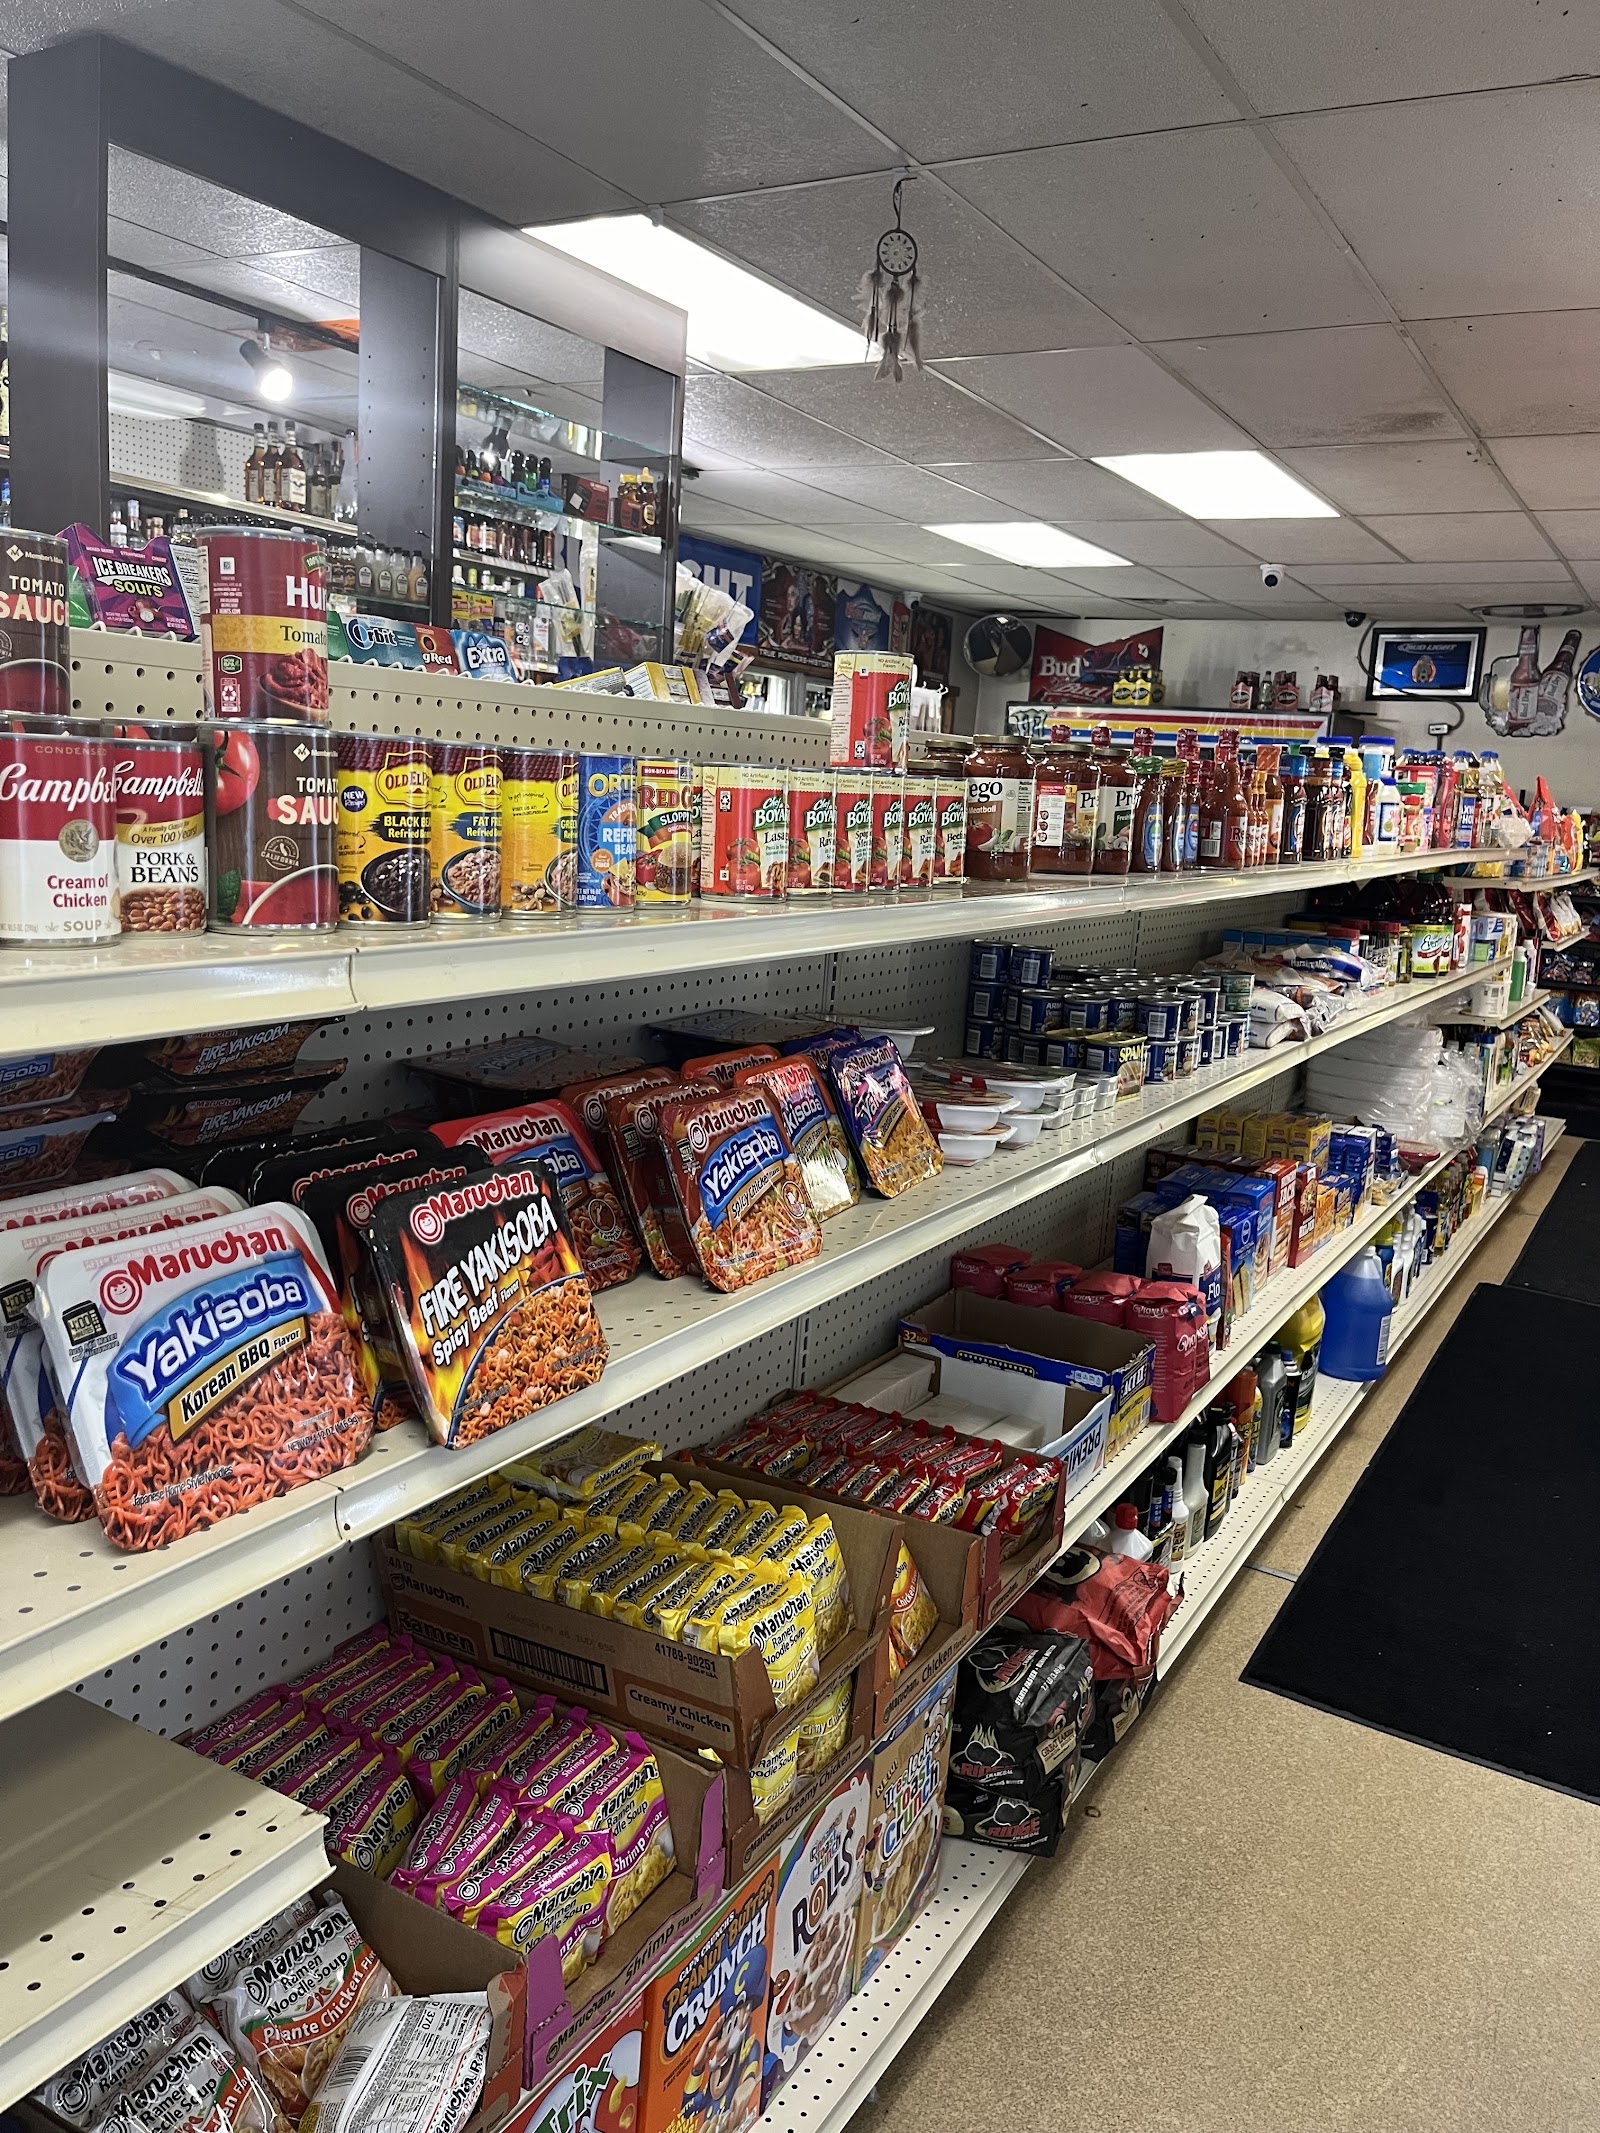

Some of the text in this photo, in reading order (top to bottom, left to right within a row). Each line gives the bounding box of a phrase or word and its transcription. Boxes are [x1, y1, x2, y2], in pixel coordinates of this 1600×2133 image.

[9, 575, 65, 597] TOMATO
[92, 556, 172, 587] ICE BREAKERS
[347, 618, 397, 650] Orbit
[467, 646, 506, 669] Extra
[1040, 655, 1081, 677] Bud
[343, 791, 364, 801] NEW
[385, 771, 422, 791] OLD EL
[464, 777, 484, 793] OLD
[588, 773, 637, 798] ORTE
[638, 785, 675, 811] RED
[384, 815, 419, 827] BLACK
[388, 825, 420, 839] Refried
[467, 826, 494, 838] Refried
[473, 816, 489, 827] FAT
[131, 834, 157, 845] Over
[160, 831, 175, 842] 100
[131, 866, 199, 883] BEANS
[136, 852, 195, 865] PORK &
[260, 850, 300, 867] CALIFORNIA
[47, 874, 109, 889] Cream of
[53, 893, 107, 907] Chicken
[63, 919, 102, 932] SOUP
[199, 1023, 290, 1063] FIRE YAKISOBA
[1119, 1045, 1144, 1063] SPAM
[194, 1058, 217, 1074] Spicy
[201, 1090, 293, 1133] FIRE YAKISOBA
[702, 1096, 768, 1135] Maruchan
[474, 1116, 567, 1154] Maruchan
[704, 1129, 779, 1201] Yakisoba
[430, 1171, 536, 1220] Maruchan
[732, 1191, 750, 1219] Spicy
[128, 1227, 288, 1288] Maruchan
[420, 1194, 558, 1338] FIRE YAKISOBA
[125, 1276, 303, 1394] Yakisoba
[433, 1279, 520, 1366] Spicy Beef Flavor
[903, 1330, 917, 1343] 32
[181, 1328, 301, 1423] Korean BBQ Flavor
[132, 1465, 234, 1507] Japanese Home Style Noodles
[896, 1583, 917, 1612] Chicken
[755, 1591, 810, 1641] Maruchan
[398, 1610, 476, 1656] Ramen
[764, 1626, 806, 1665] Noodle Soup
[772, 1623, 796, 1649] Ramen
[654, 1643, 716, 1672] 41789-90251
[921, 1646, 953, 1683] Chicken
[629, 1688, 731, 1734] Creamy Chicken
[666, 1714, 695, 1732] Flavor
[758, 1747, 787, 1769] Ramen
[778, 1750, 797, 1771] Soup
[785, 1752, 852, 1823] Creamy Chicken
[875, 1758, 899, 1799] NEW!
[884, 1768, 909, 1810] Tres
[894, 1752, 933, 1816] Toast
[364, 1778, 414, 1850] Maruchan
[606, 1799, 636, 1827] Ramen
[625, 1799, 649, 1827] Soup
[883, 1760, 941, 1860] Crunch
[388, 1820, 415, 1852] Soup
[466, 1830, 487, 1855] Shrimp
[613, 1809, 664, 1873] Shrimp Flavor
[531, 1863, 608, 1924] Maruchan
[791, 1826, 854, 1956] ROLLS
[543, 1897, 577, 1929] Ramen
[562, 1902, 593, 1926] Soup
[573, 1914, 602, 1938] Flavor
[233, 1926, 279, 1966] Ramen
[253, 1910, 349, 1985] Maruchan
[625, 1903, 704, 1985] Shrimp Flavor
[666, 1941, 723, 2015] PEANUT
[728, 1871, 774, 1943] BUTTER
[267, 1951, 349, 2020] Noodle Soup
[280, 1954, 324, 1992] Ramen
[666, 1902, 770, 2054] CRUNCH
[321, 1968, 365, 2028] Chicken
[421, 2009, 436, 2030] 370
[99, 2047, 150, 2095] Ramen
[533, 2052, 612, 2133] Trix
